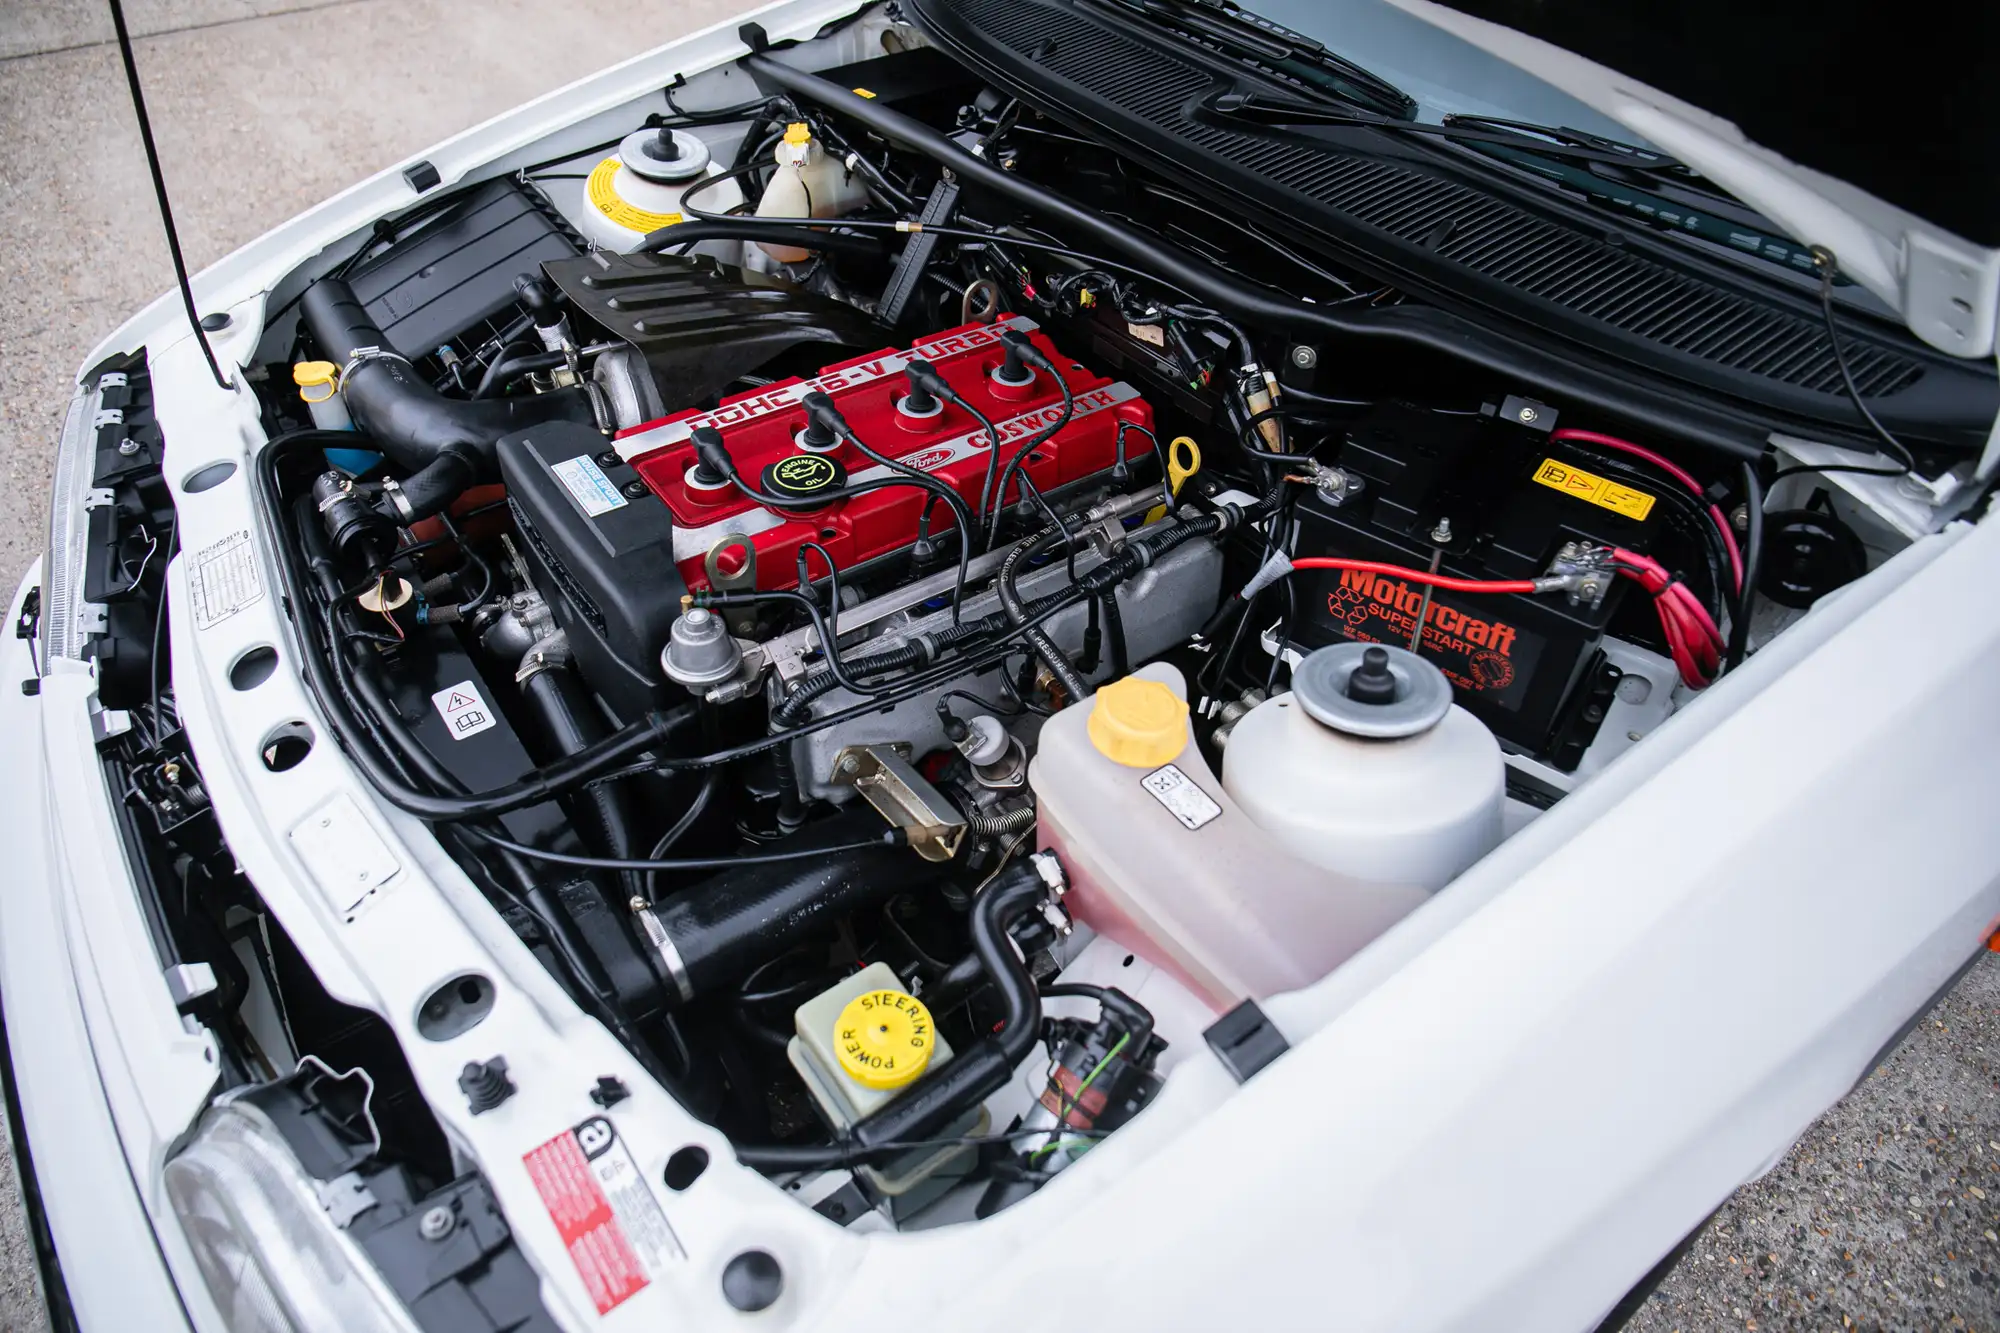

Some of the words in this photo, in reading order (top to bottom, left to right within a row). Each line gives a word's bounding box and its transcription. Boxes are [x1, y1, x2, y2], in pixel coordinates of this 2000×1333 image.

[781, 459, 816, 473] ENGINE
[905, 452, 943, 469] Ford
[597, 478, 625, 507] SPORT
[804, 477, 823, 486] OIL
[1022, 534, 1041, 548] LINE
[1000, 547, 1023, 583] SLEEVING
[1340, 568, 1517, 657] Motorcraft
[1034, 635, 1068, 674] PRESSURE
[1064, 673, 1084, 696] FUEL
[861, 993, 928, 1048] STEERING
[842, 1029, 895, 1070] POWER
